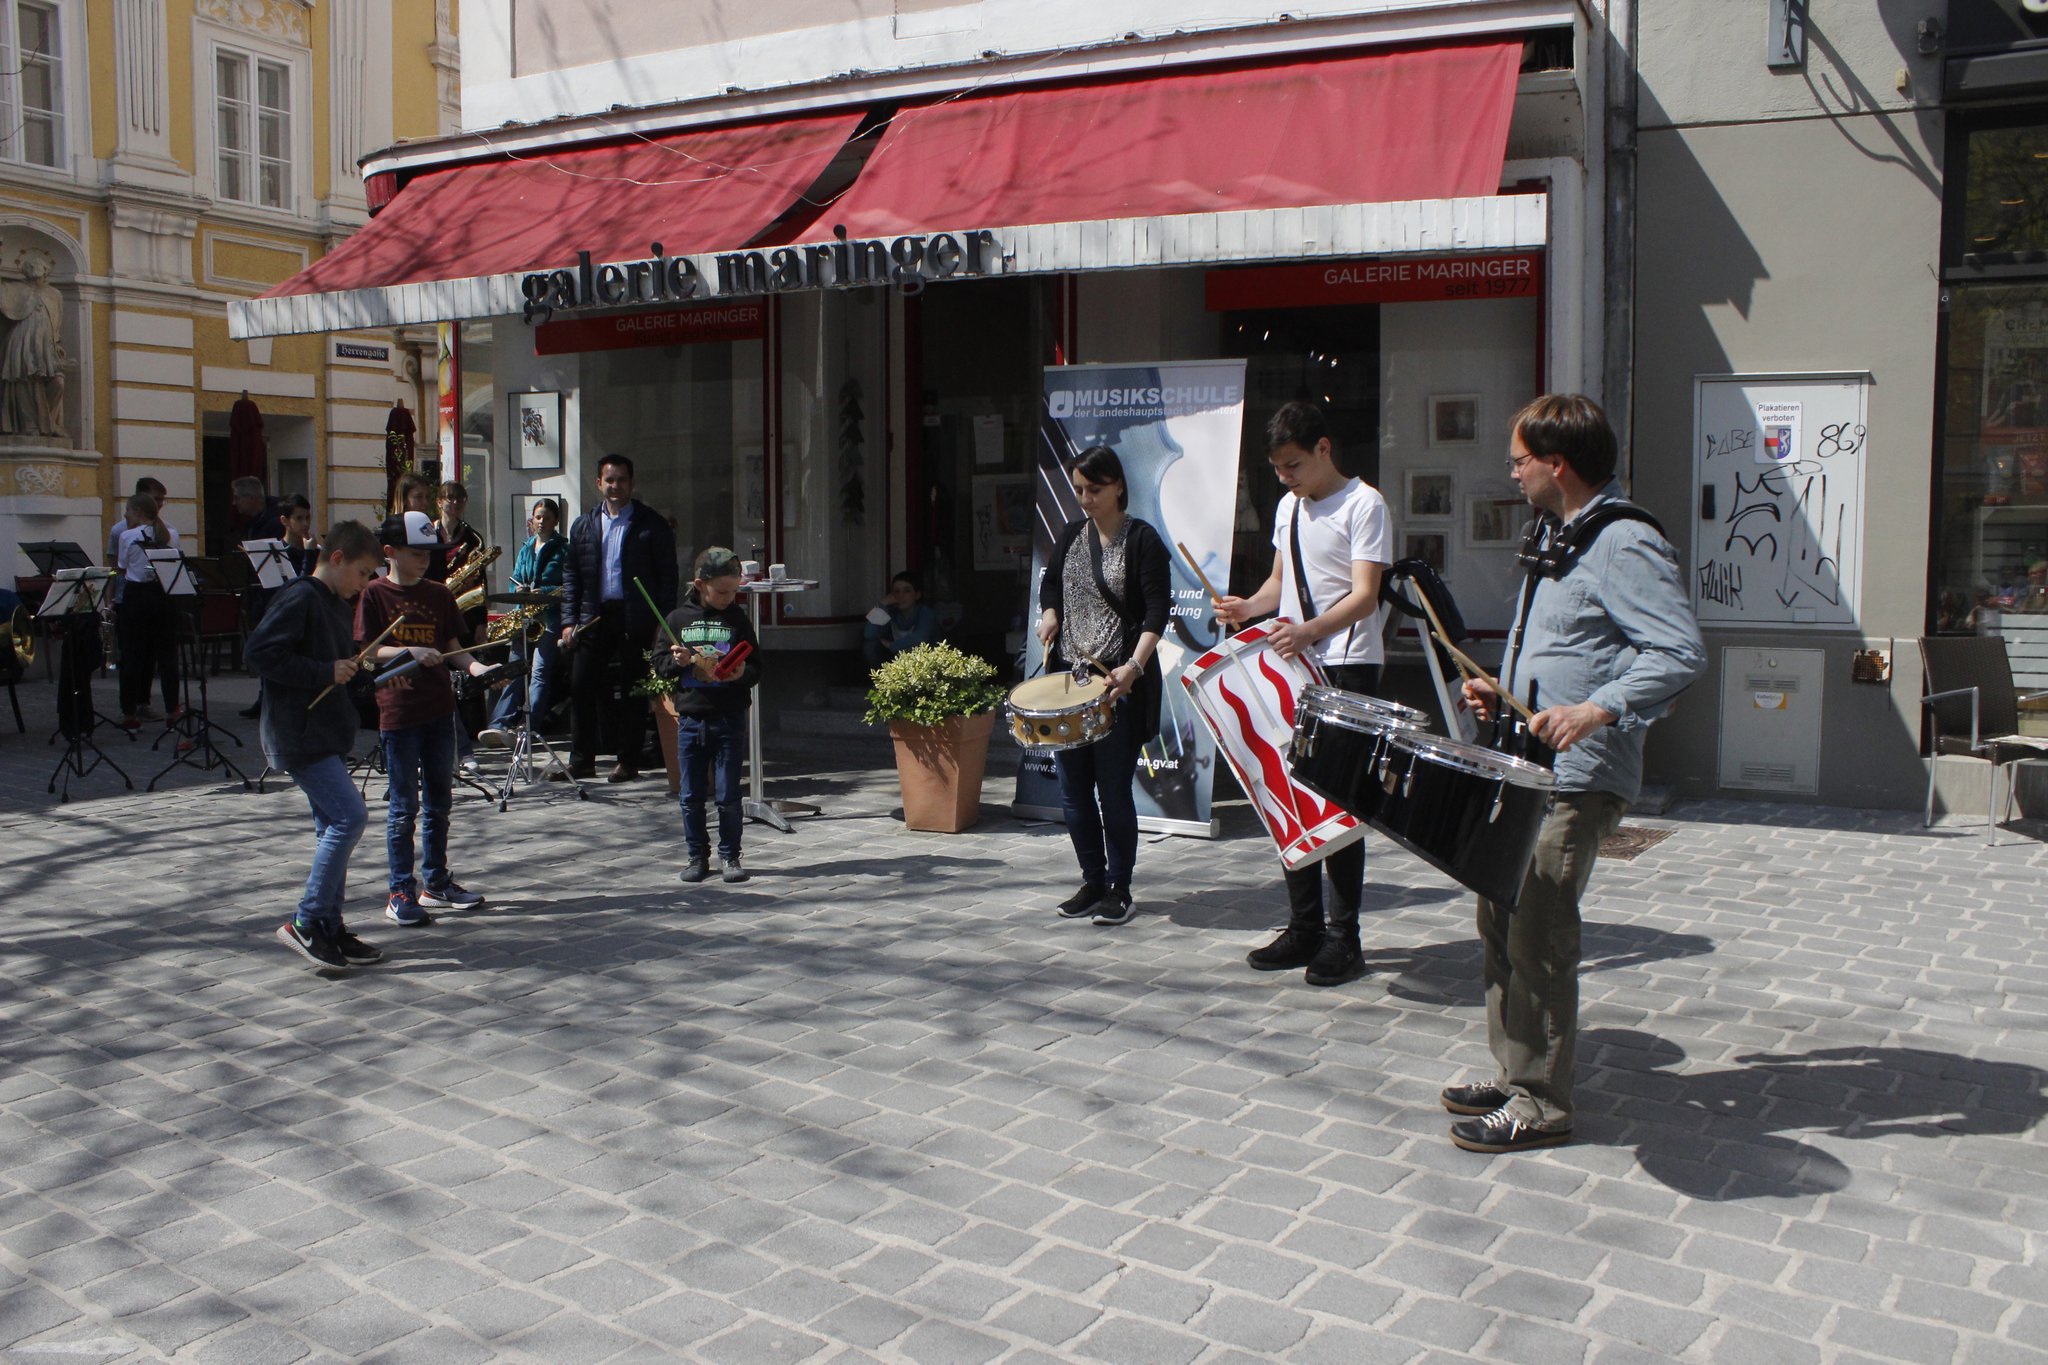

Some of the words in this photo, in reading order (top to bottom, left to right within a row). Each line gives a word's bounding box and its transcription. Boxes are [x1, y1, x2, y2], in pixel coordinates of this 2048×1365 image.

[521, 242, 697, 326] galerie
[715, 224, 994, 296] maringer
[1324, 265, 1411, 285] GALERIE
[1417, 259, 1530, 280] MARINGER
[1445, 280, 1478, 297] seit
[1486, 277, 1531, 296] 1977
[616, 313, 676, 332] GALERIE
[679, 307, 759, 328] MARINGER
[1074, 385, 1238, 407] MUSIKSCHULE
[1074, 407, 1090, 418] der
[1093, 405, 1184, 418] Landeshauptstadt
[1758, 403, 1800, 412] Plakatieren
[1762, 414, 1795, 422] verboten
[1179, 587, 1204, 599] und
[392, 624, 436, 645] VANS
